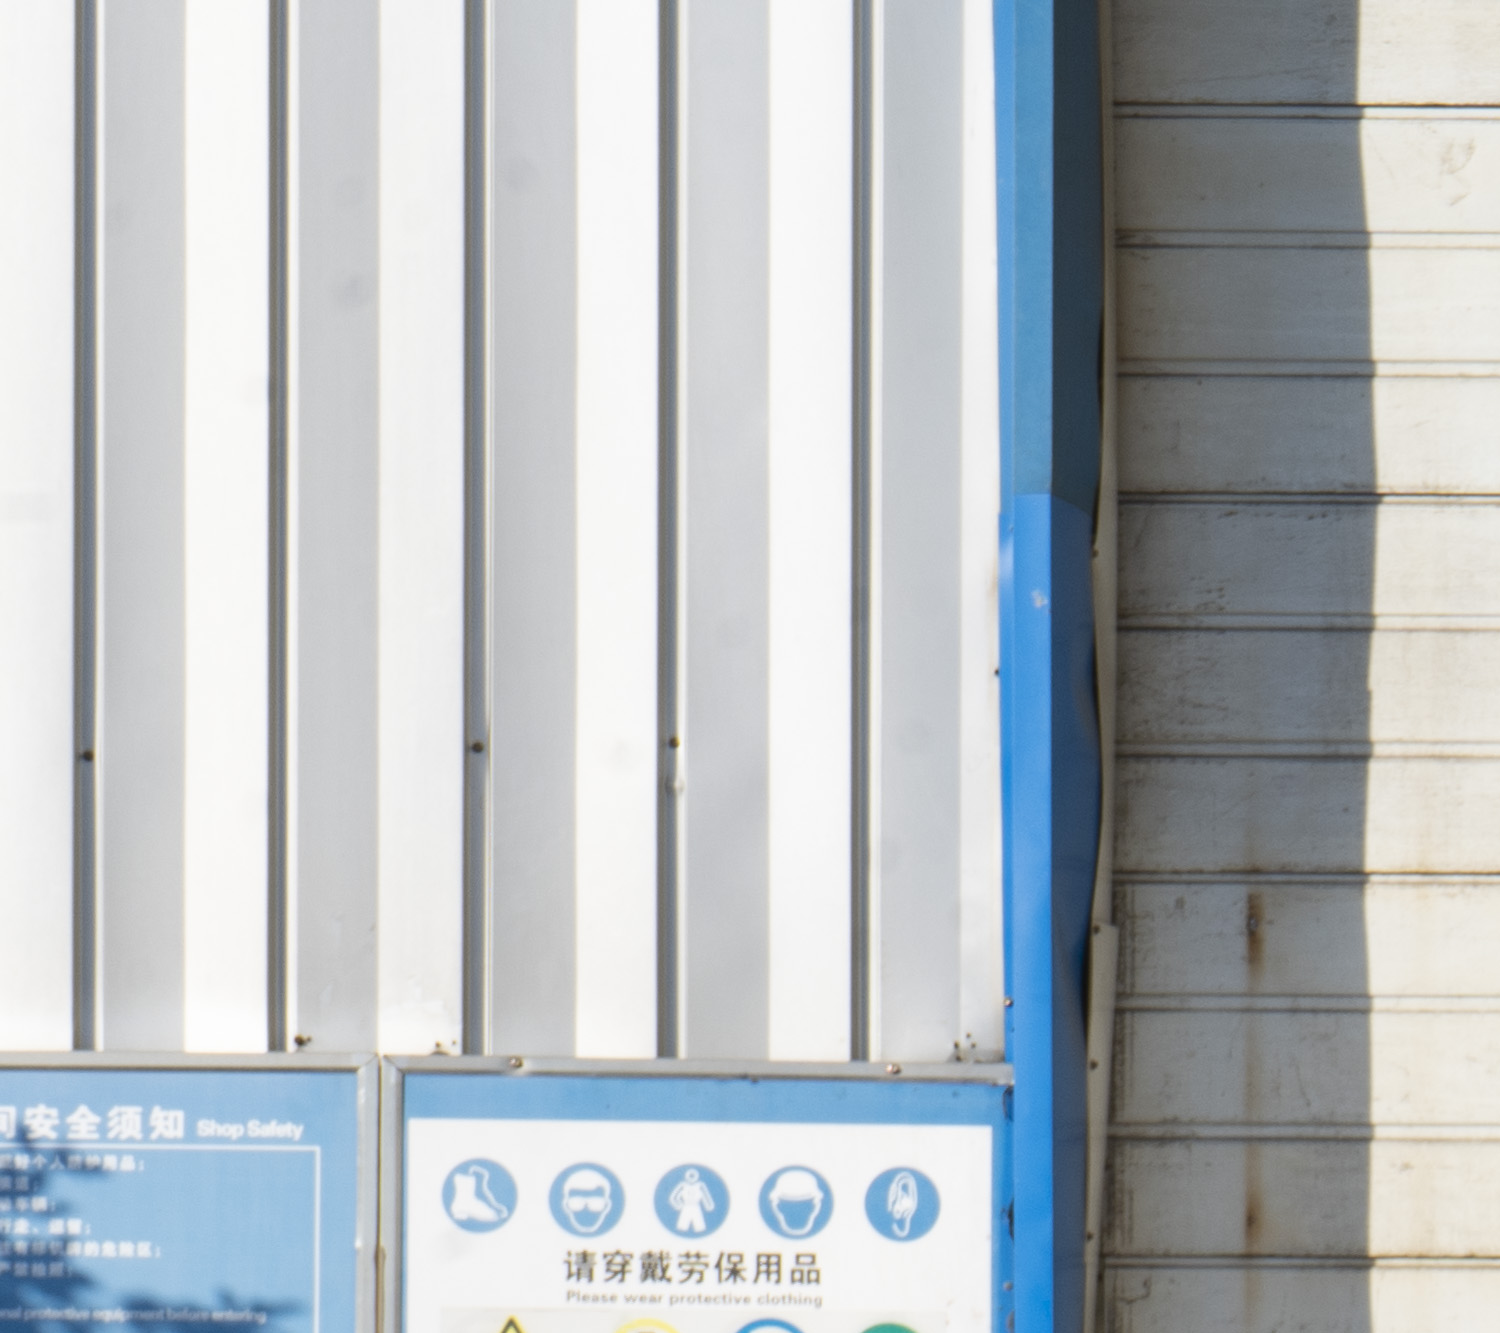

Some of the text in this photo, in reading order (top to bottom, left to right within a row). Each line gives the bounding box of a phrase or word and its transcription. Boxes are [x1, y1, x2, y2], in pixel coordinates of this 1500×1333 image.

[197, 1118, 304, 1142] Shop Safety
[563, 1249, 822, 1285] 请穿戴劳保用品
[565, 1289, 824, 1309] Please wear protective clothing
